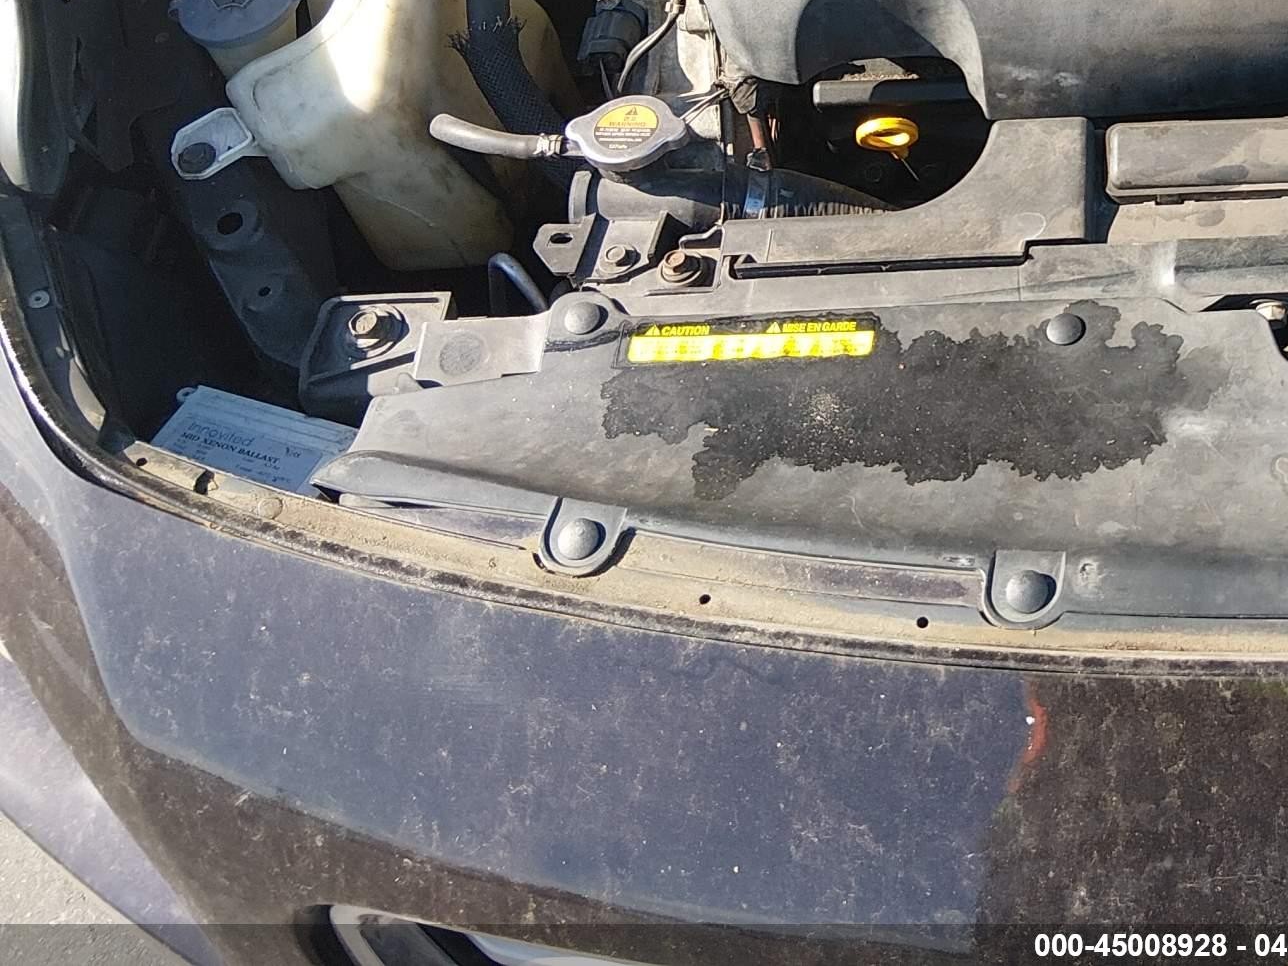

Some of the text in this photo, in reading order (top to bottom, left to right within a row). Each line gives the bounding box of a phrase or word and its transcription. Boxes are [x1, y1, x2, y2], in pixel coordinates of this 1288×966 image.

[661, 324, 710, 336] CAUTION
[782, 321, 857, 333] MISE EN GARDE
[203, 438, 238, 452] XENON
[238, 448, 281, 464] BALLAST
